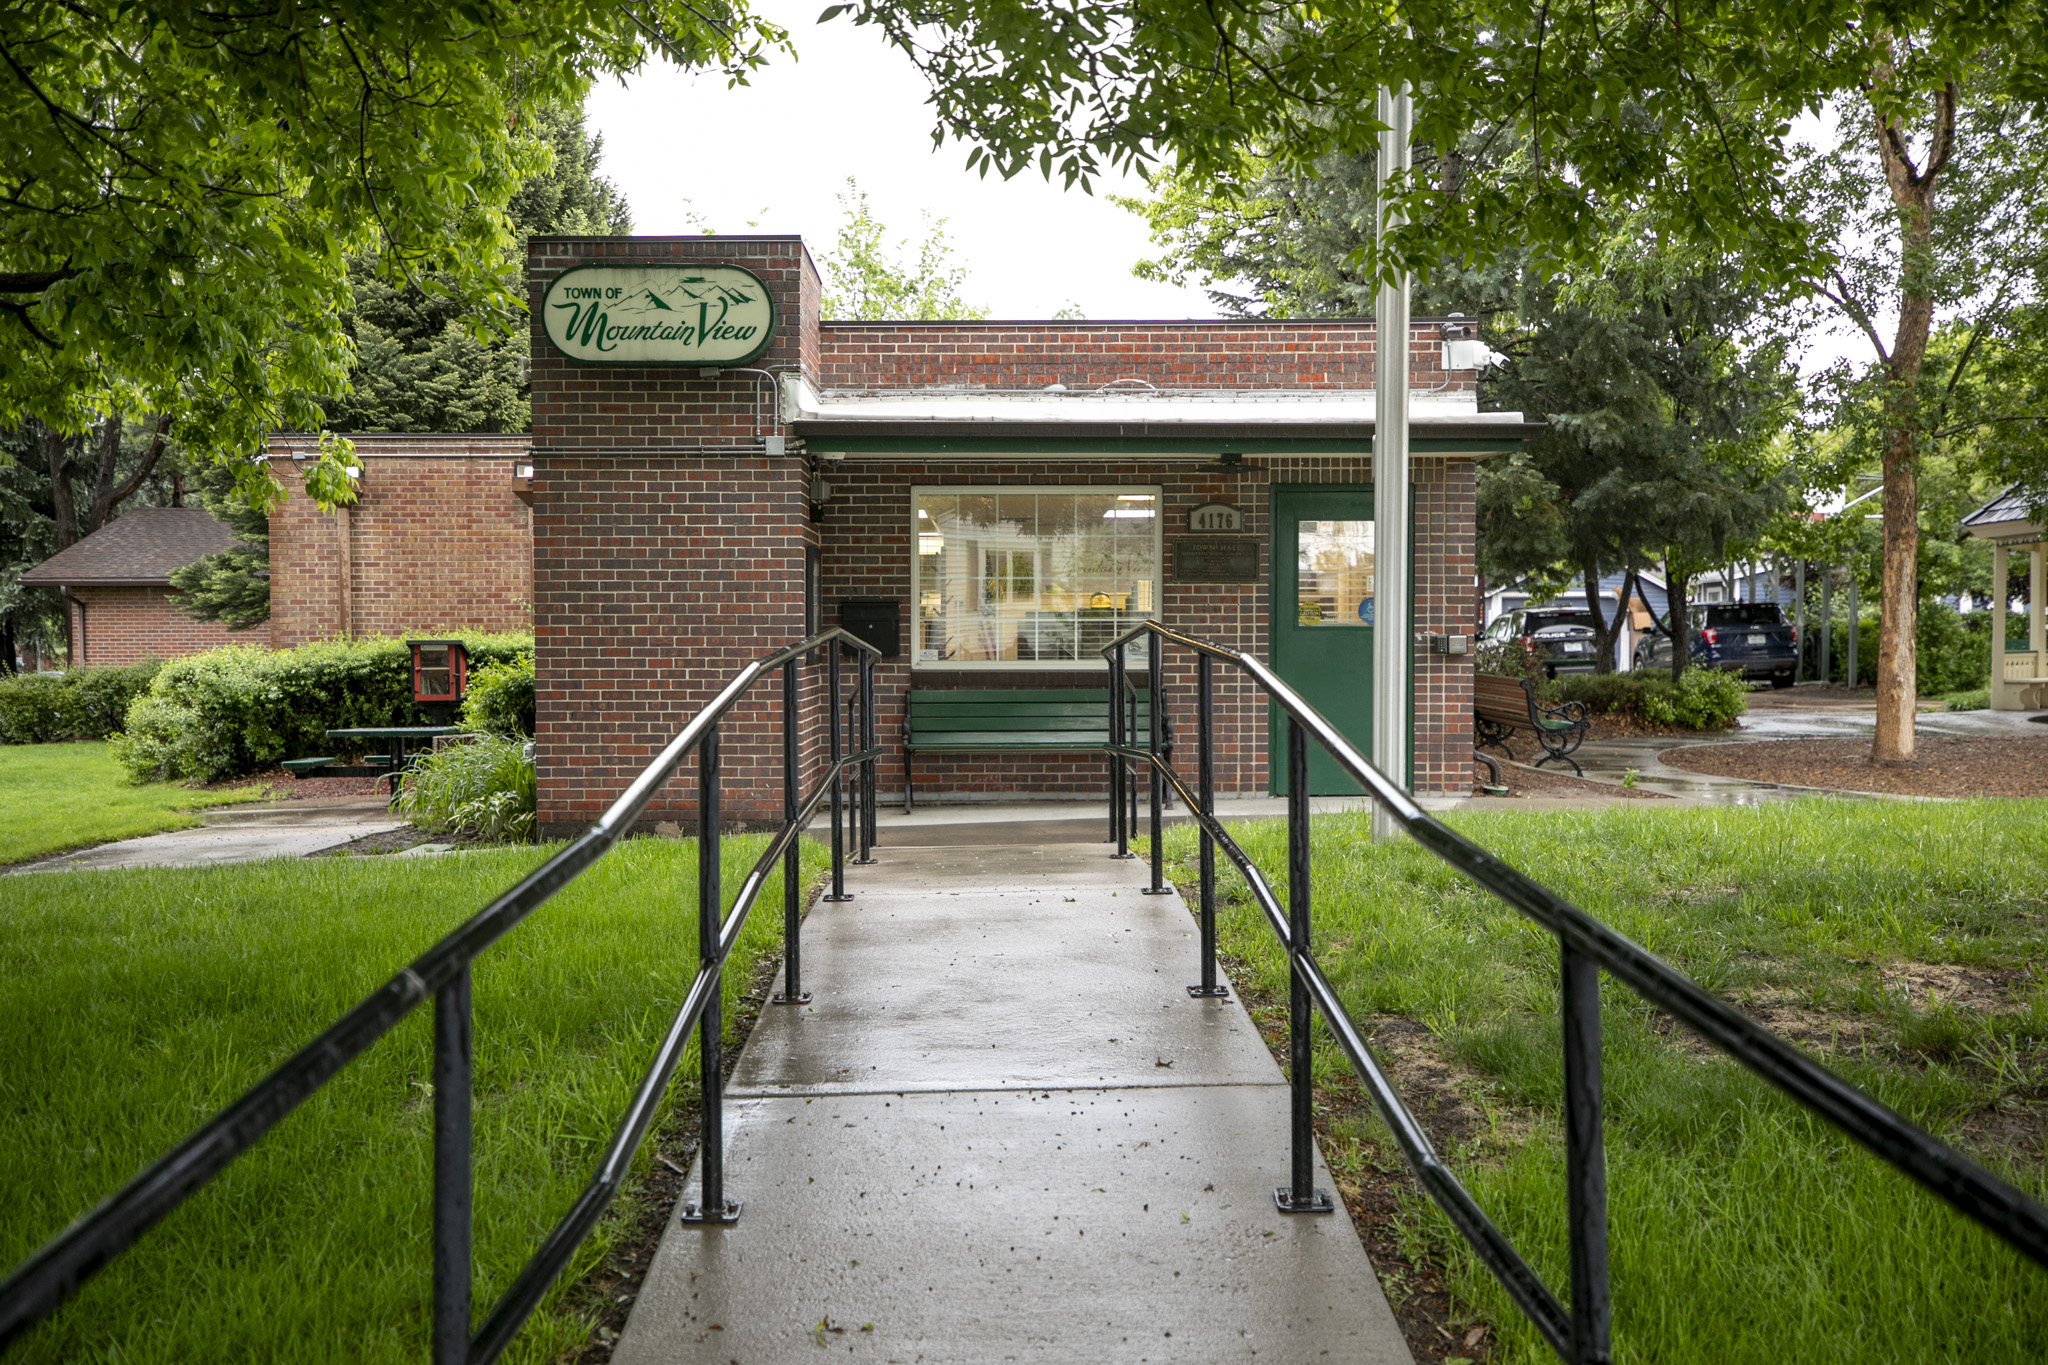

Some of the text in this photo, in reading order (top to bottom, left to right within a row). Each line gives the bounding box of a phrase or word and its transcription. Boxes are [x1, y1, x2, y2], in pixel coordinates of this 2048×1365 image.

[564, 287, 623, 299] TOWN OF
[551, 296, 757, 352] Mountain View
[1198, 512, 1233, 529] 4176
[1062, 556, 1122, 575] Muntain
